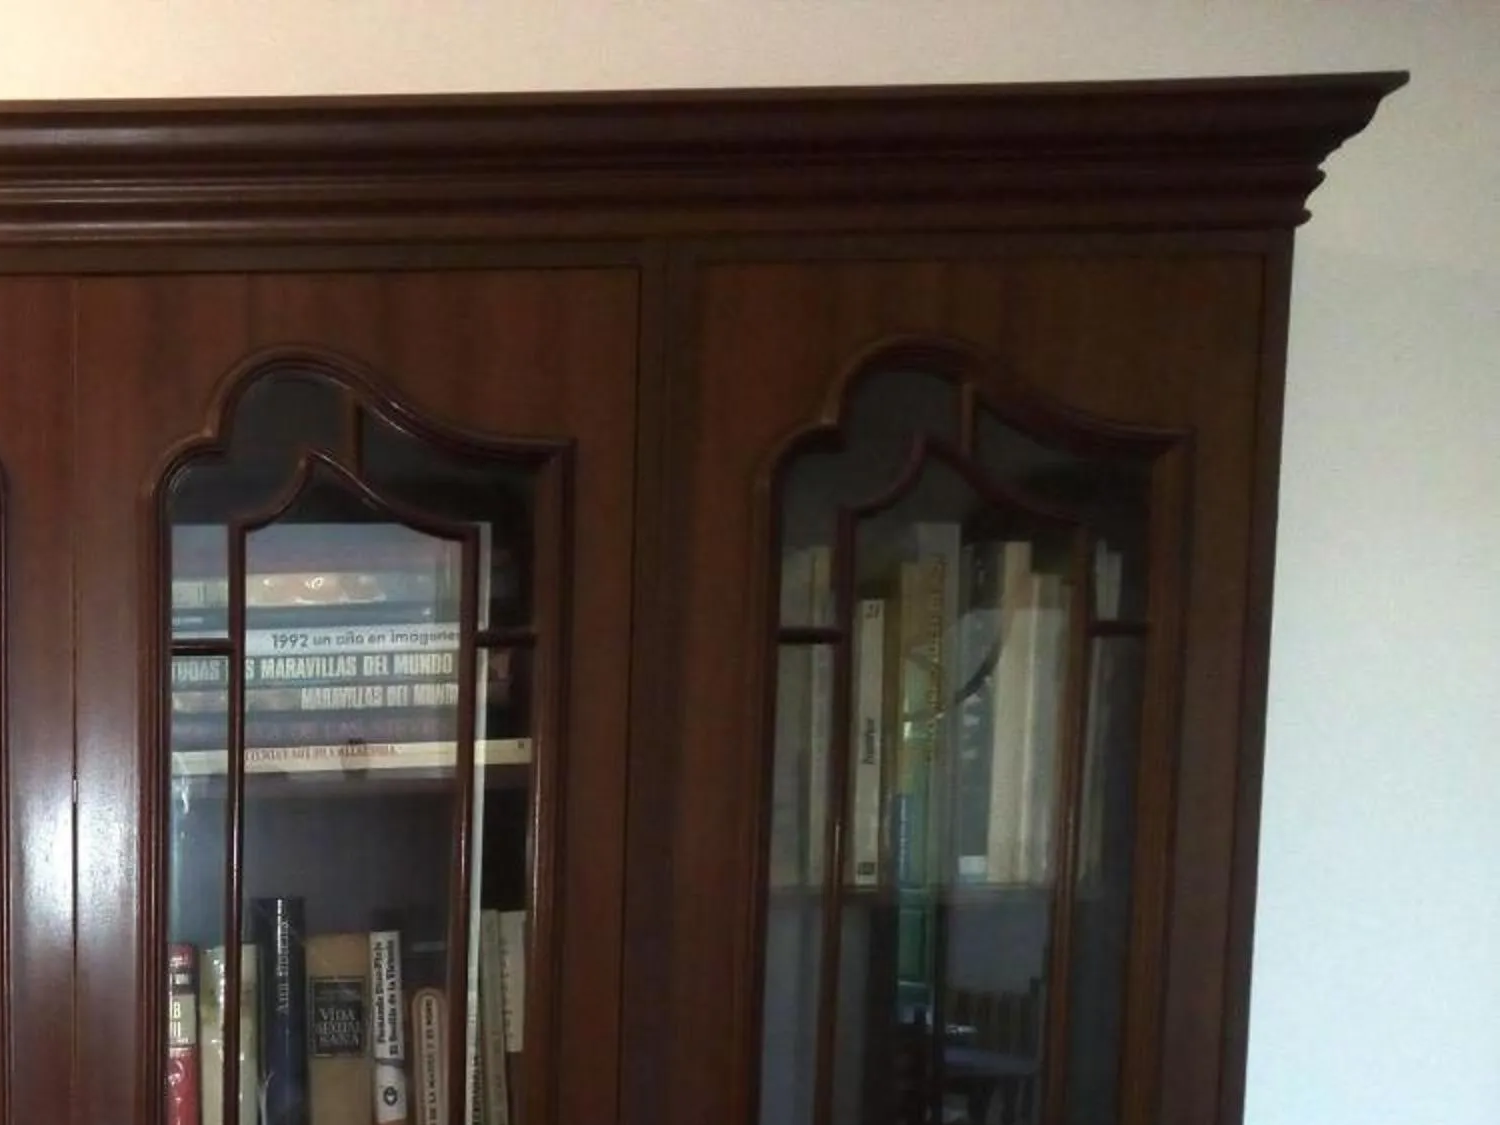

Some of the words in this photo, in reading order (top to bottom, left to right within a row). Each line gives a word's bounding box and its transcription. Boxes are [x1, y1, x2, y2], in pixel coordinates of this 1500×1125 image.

[271, 633, 309, 649] 1992
[312, 635, 331, 646] un
[336, 631, 364, 646] año
[367, 633, 386, 644] en
[260, 655, 357, 679] MARAVILLAS
[362, 654, 390, 676] DEL
[393, 652, 453, 675] MUNDO
